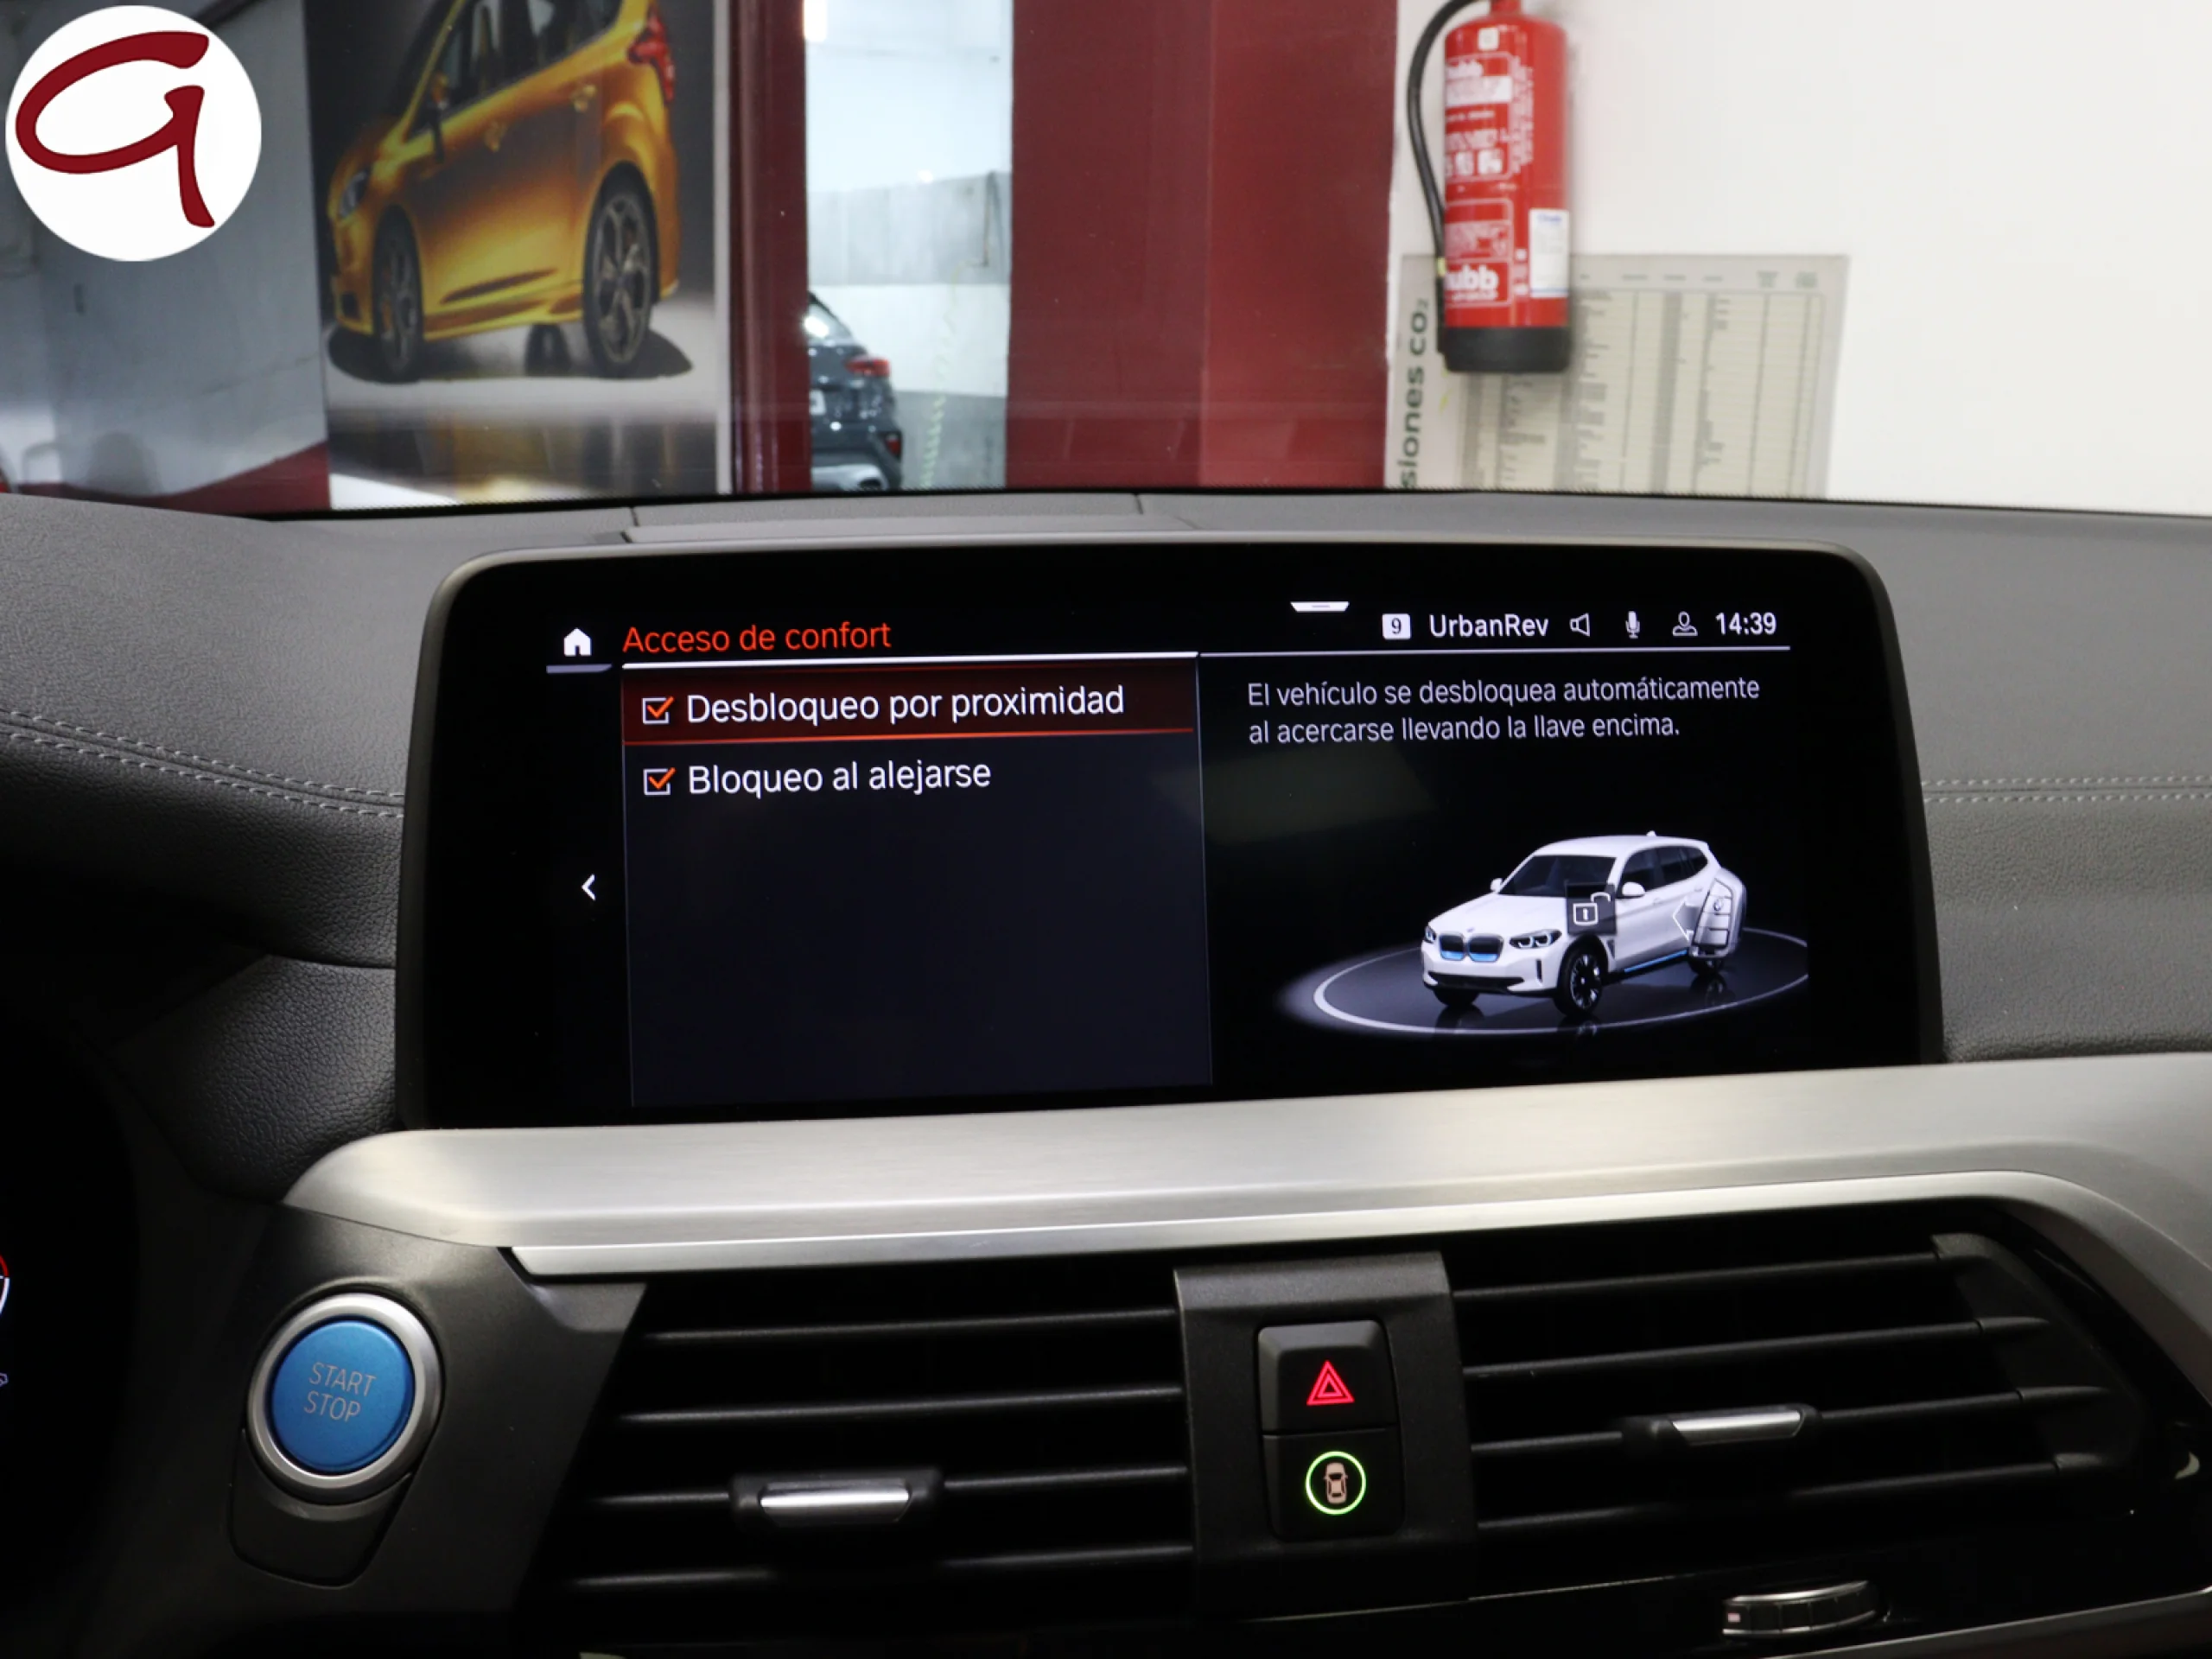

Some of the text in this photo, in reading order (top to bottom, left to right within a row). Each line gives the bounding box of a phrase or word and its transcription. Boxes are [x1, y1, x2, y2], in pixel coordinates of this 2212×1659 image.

[623, 621, 891, 652] Acceso de confort
[1430, 613, 1548, 638] UrbanRev
[1715, 612, 1777, 635] 14:39
[686, 685, 1124, 727] Desbloqueo por proximidad
[1248, 677, 1760, 708] El vehículo se desbloquea automáticamente
[1249, 713, 1680, 744] al acercarse llevando la llave encima.
[688, 760, 992, 800] Bloqueo al alejarse
[309, 1362, 377, 1396] START
[304, 1390, 360, 1421] STOP
